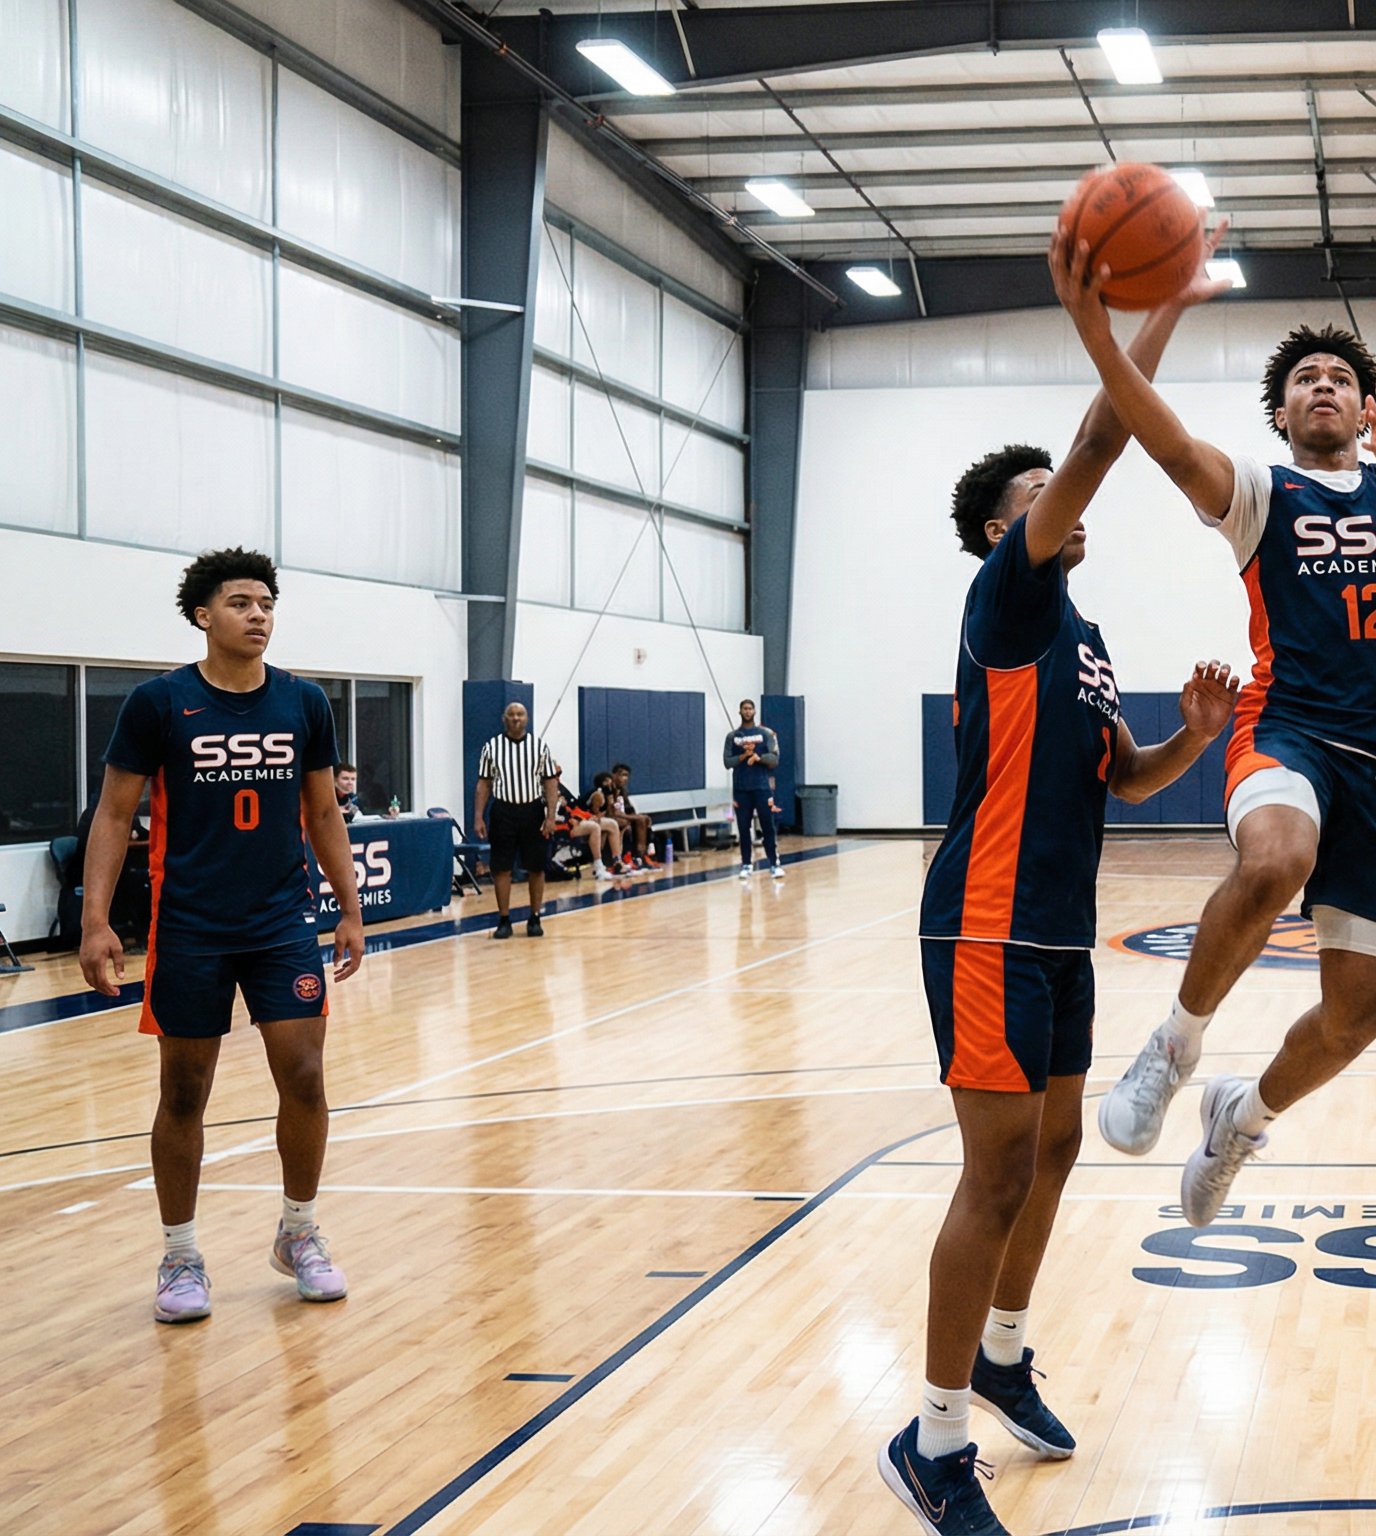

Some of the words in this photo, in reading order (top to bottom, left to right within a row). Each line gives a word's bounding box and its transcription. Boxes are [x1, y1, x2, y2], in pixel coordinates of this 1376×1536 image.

[190, 732, 295, 768] SSS
[193, 768, 294, 783] ACADEMIES
[233, 788, 260, 831] 0
